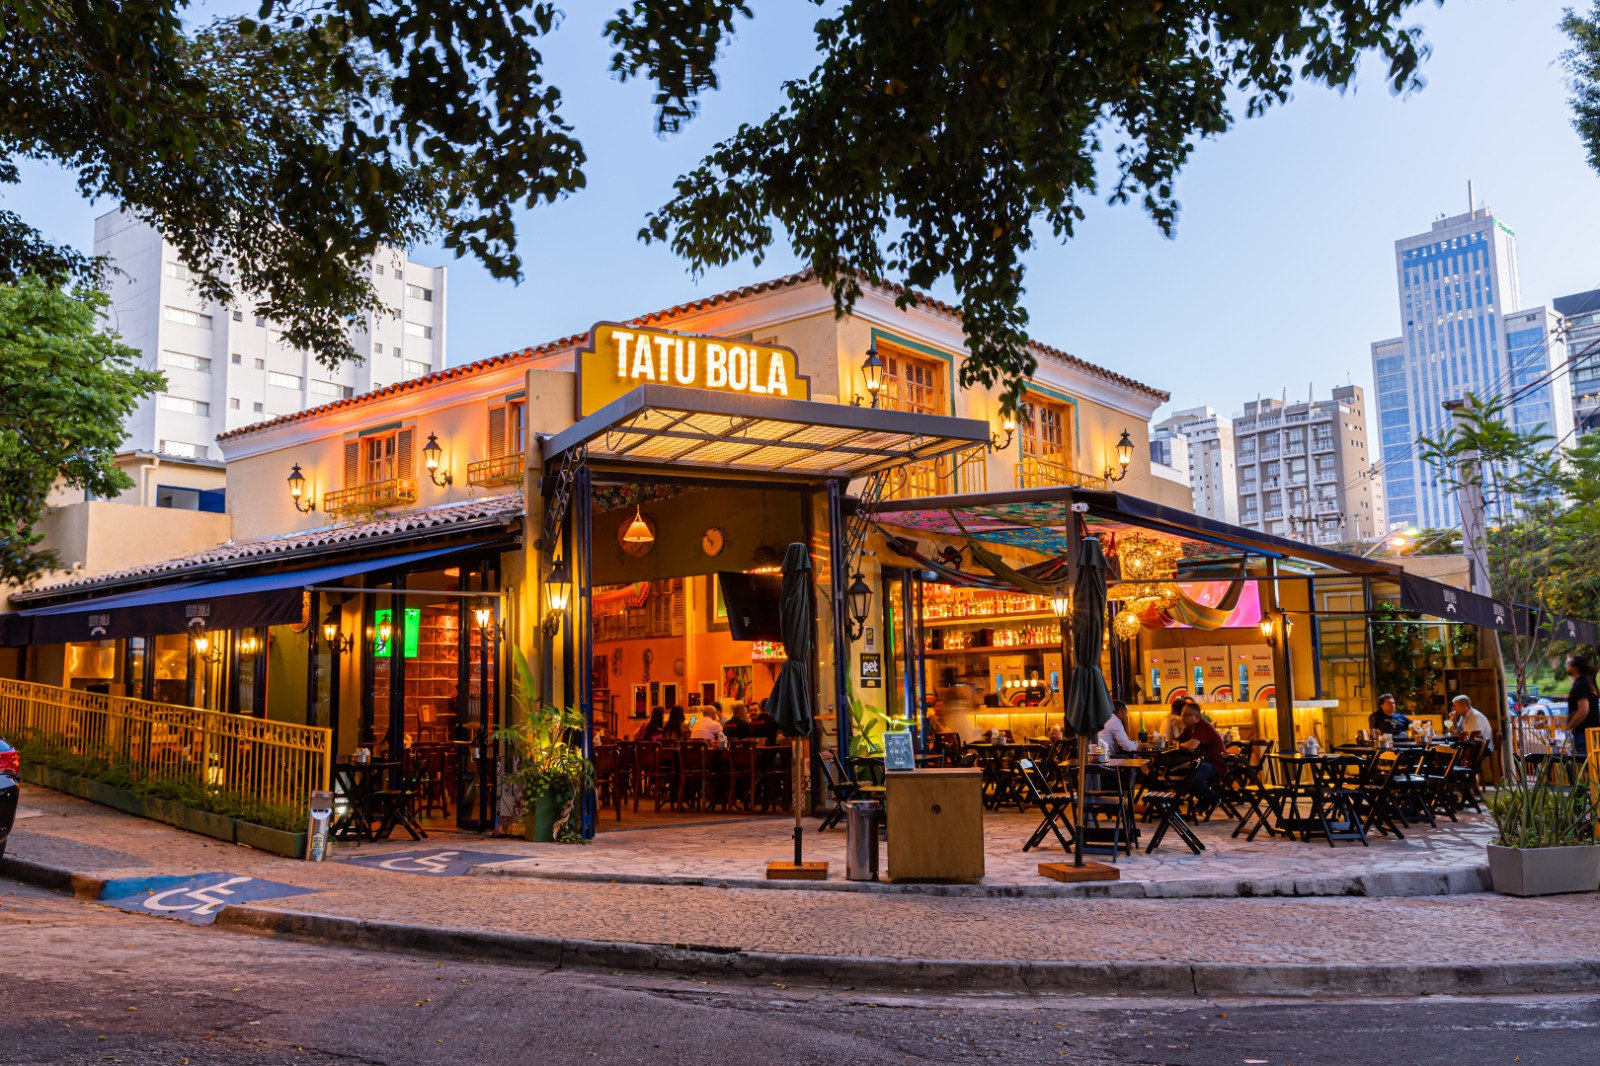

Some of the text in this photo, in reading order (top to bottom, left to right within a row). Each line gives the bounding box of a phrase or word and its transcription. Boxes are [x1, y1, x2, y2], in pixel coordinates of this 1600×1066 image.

[612, 331, 788, 395] TATU BOLA
[863, 660, 878, 675] pet
